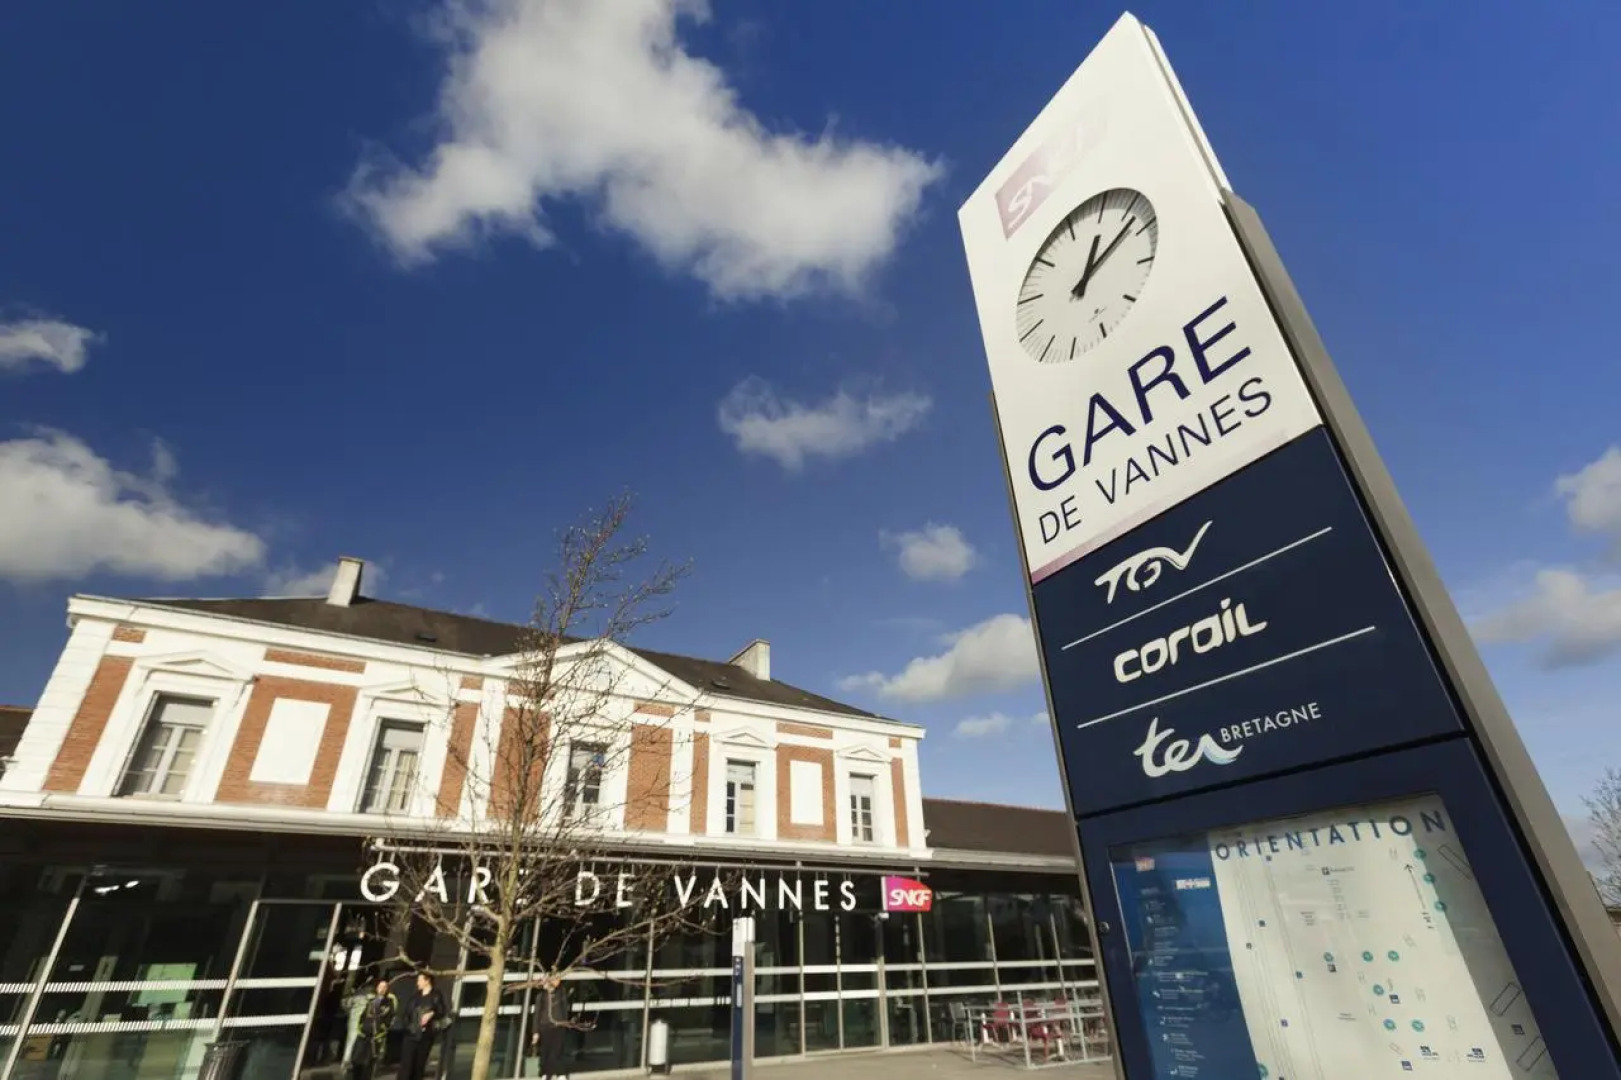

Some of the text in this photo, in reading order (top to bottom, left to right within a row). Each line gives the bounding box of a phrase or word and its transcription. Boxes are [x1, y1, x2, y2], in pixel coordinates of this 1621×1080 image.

[1028, 296, 1251, 491] GARE
[1039, 377, 1272, 544] DE VANNES
[1095, 521, 1212, 603] TGV
[1114, 598, 1267, 682] corail
[1134, 702, 1321, 777] ter BRETAGNE
[1215, 810, 1446, 860] ORIENTATION
[575, 871, 635, 907] DE
[674, 875, 856, 911] VANNES
[889, 889, 931, 906] SNCF
